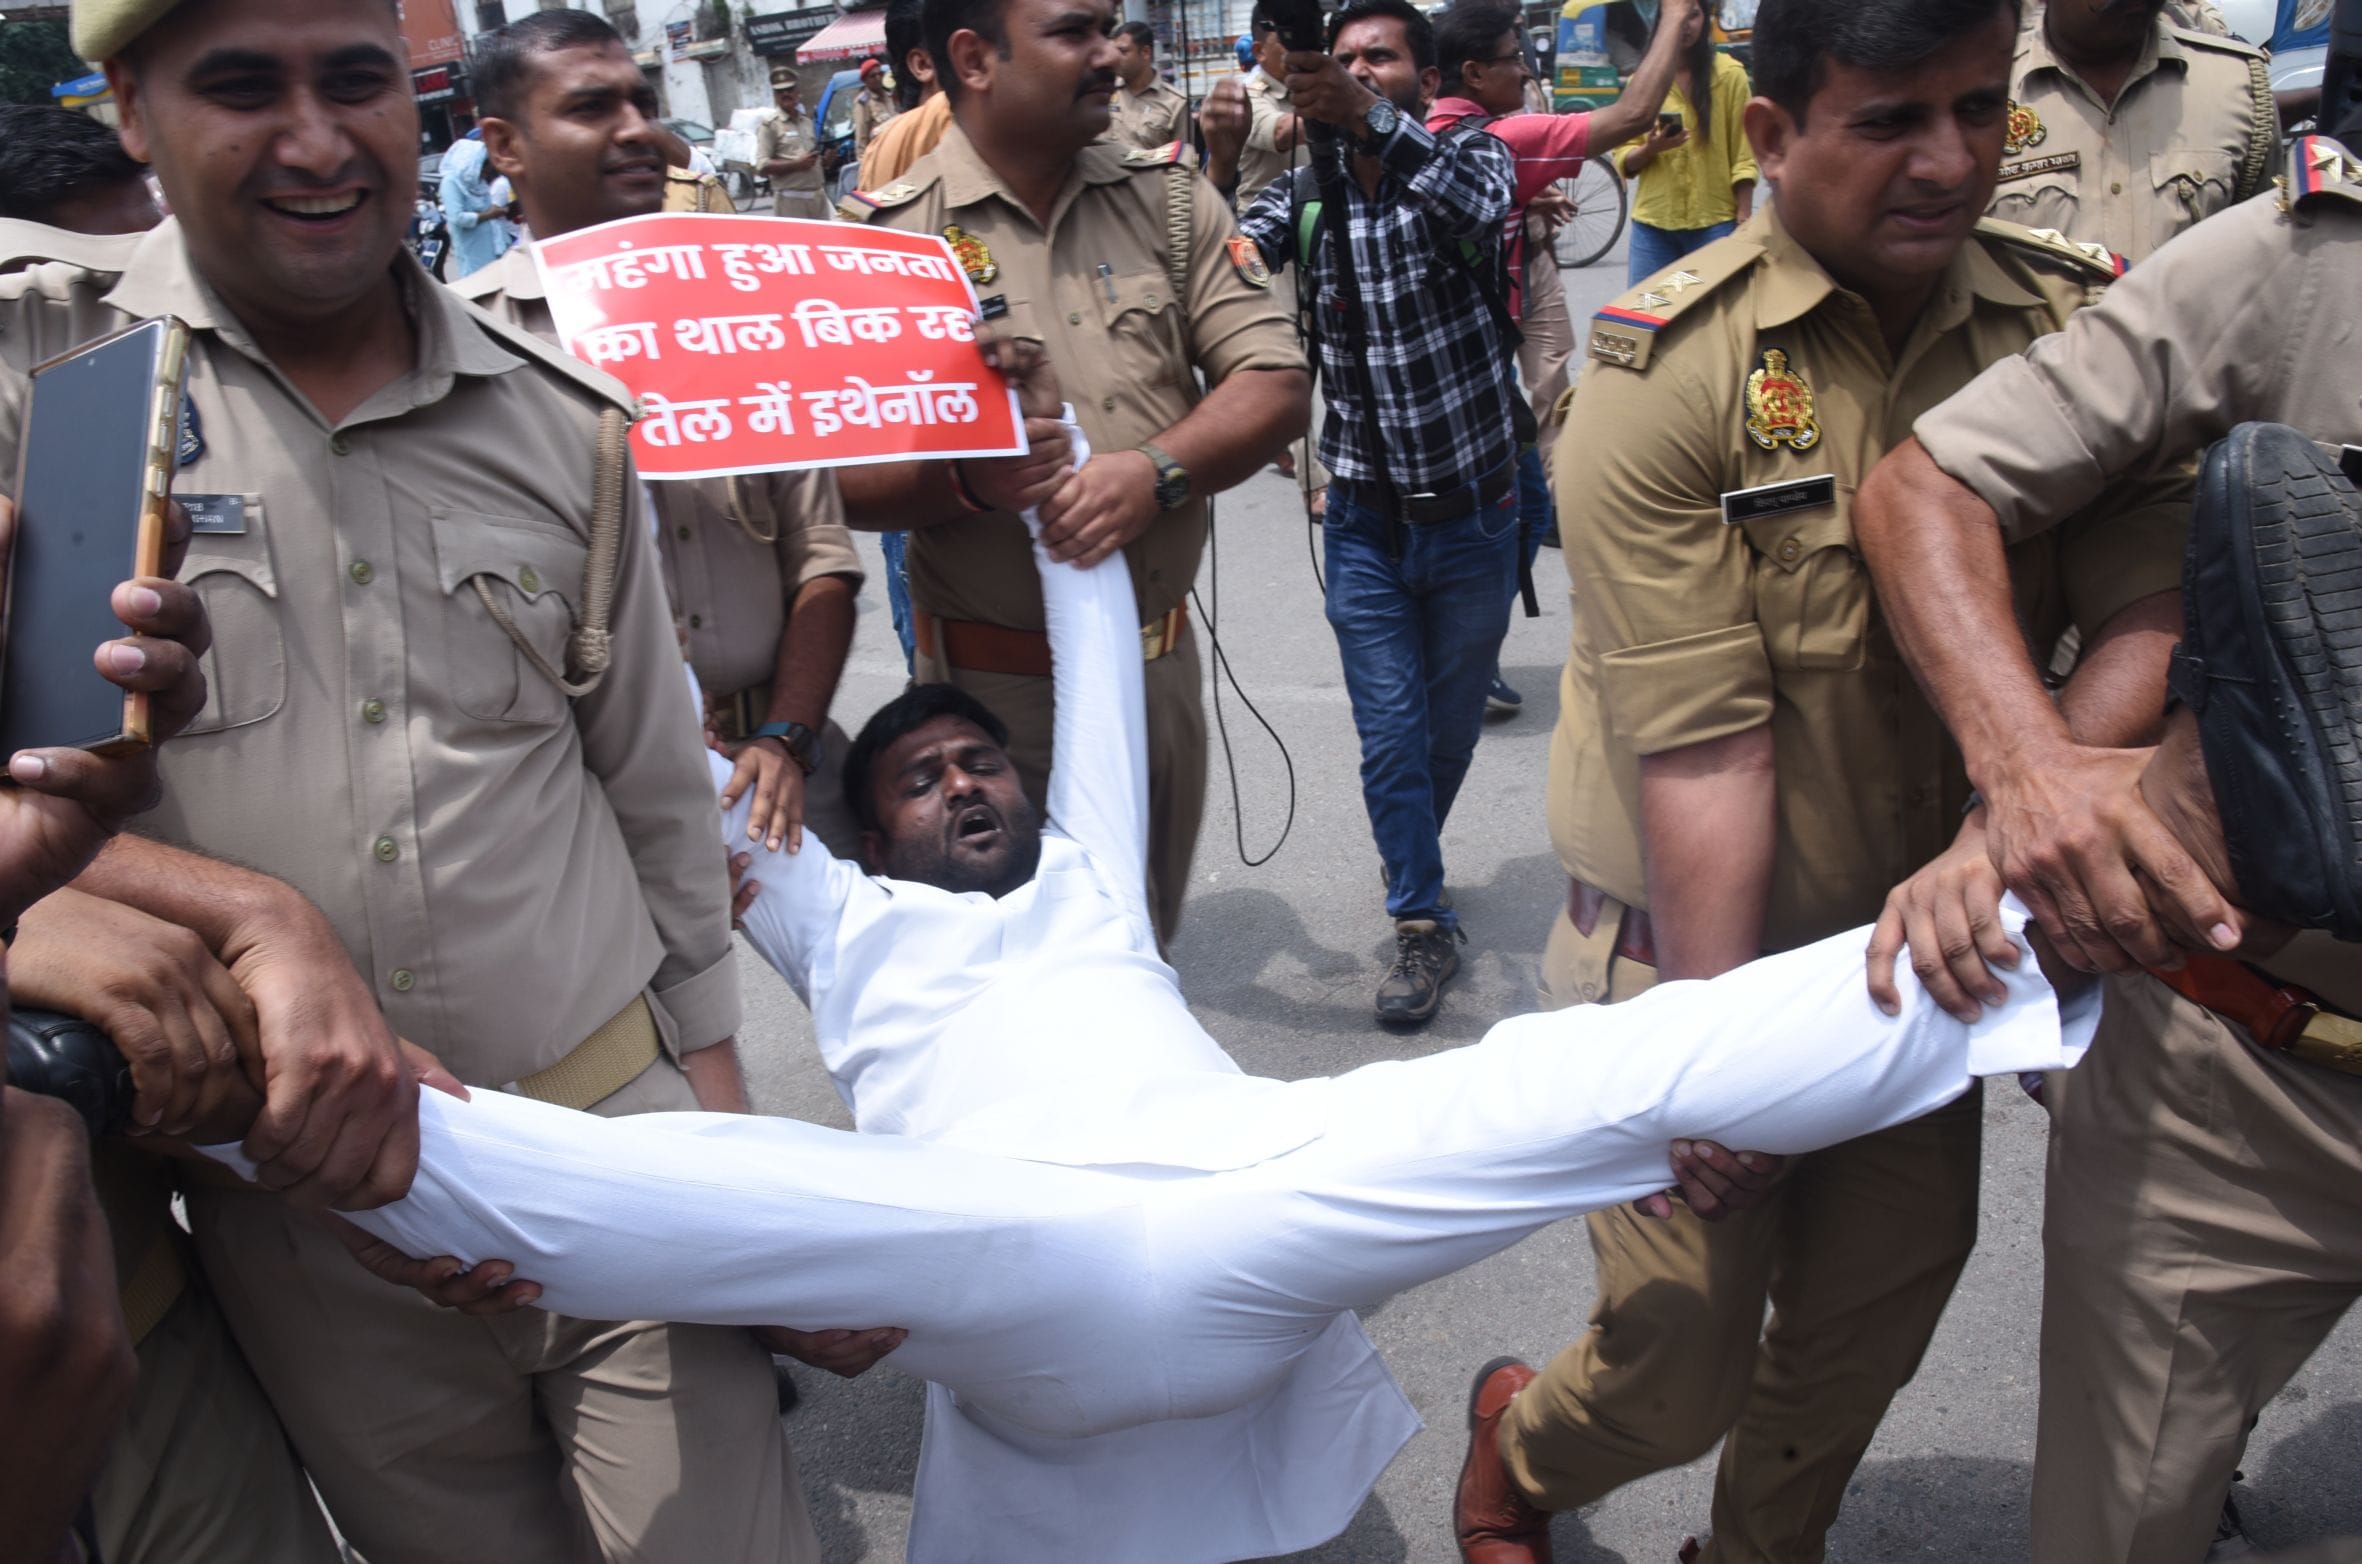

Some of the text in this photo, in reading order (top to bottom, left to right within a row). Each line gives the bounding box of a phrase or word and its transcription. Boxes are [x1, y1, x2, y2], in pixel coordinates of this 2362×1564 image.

[555, 241, 956, 292] महंगा हुआ जनता
[575, 321, 662, 367] का
[673, 313, 787, 355] थाल
[790, 298, 902, 347] बिक
[906, 306, 977, 342] रह
[640, 369, 979, 446] तेल में इथेनॉल
